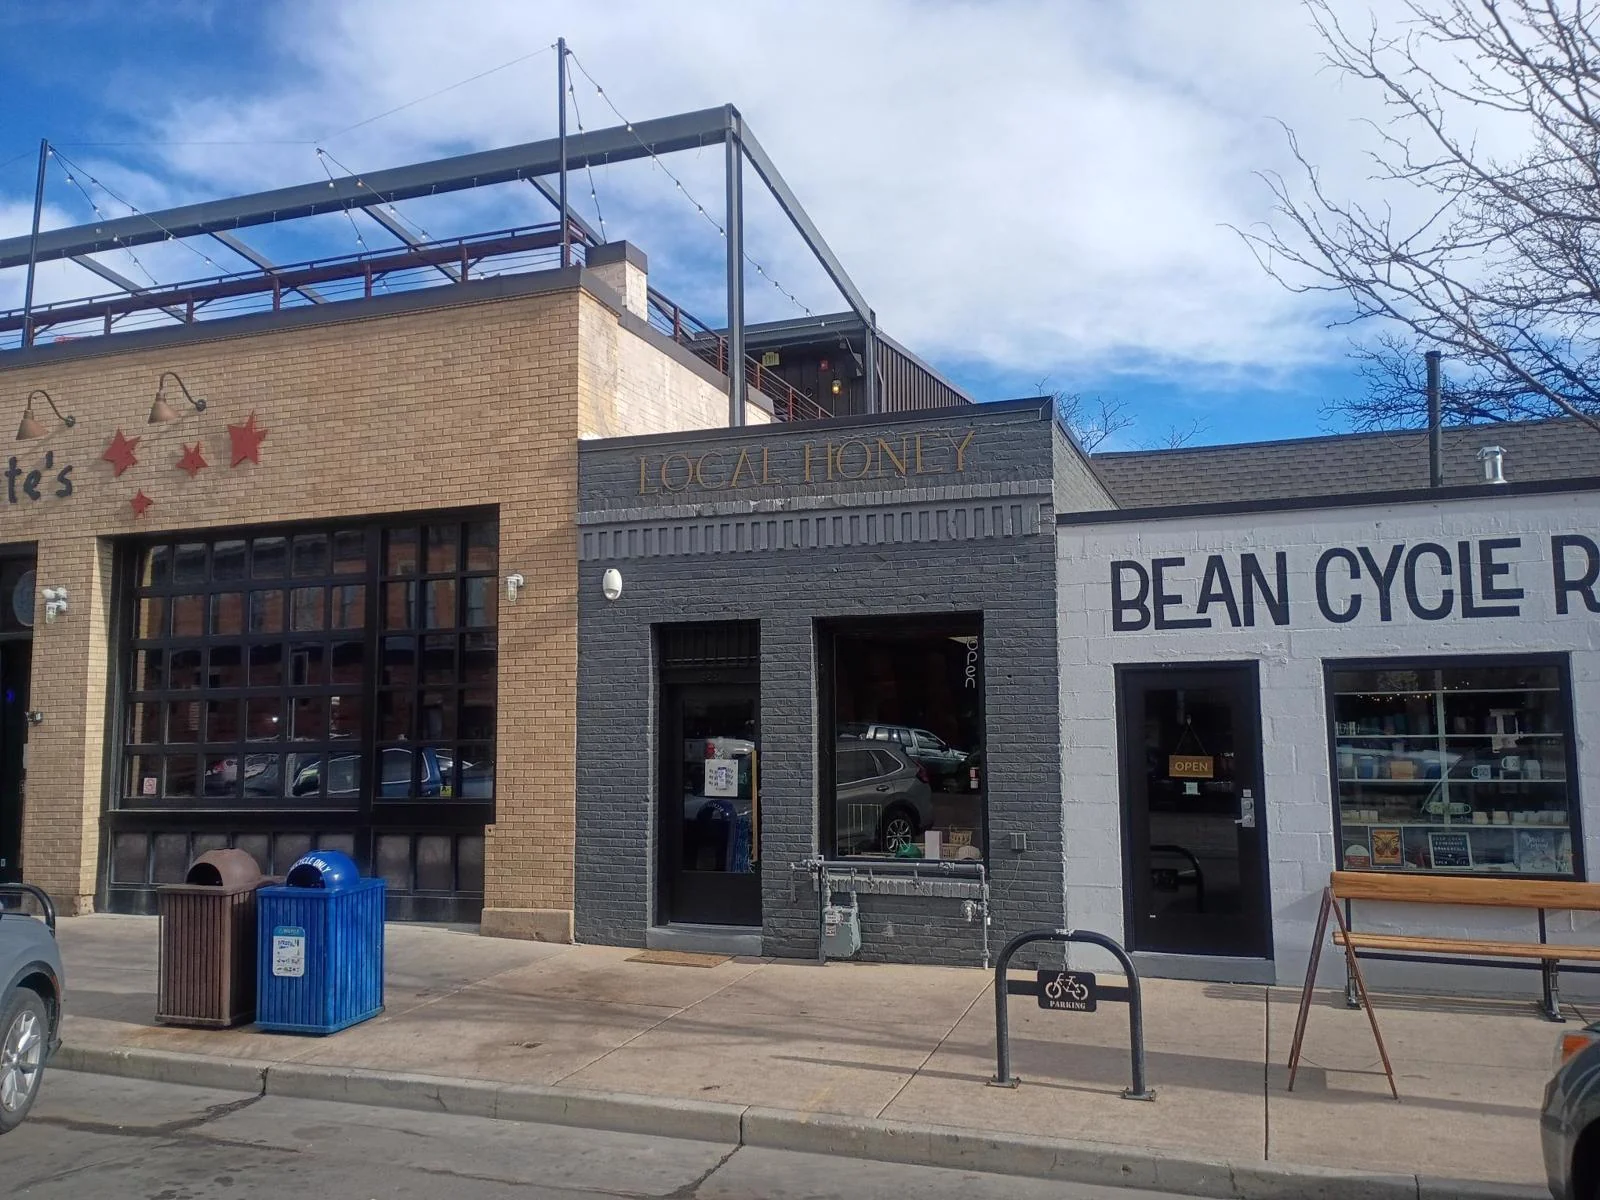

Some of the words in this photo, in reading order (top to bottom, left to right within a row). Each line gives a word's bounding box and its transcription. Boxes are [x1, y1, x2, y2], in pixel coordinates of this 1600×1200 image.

[639, 446, 782, 495] LOCAL
[803, 430, 976, 483] HONEY
[1109, 551, 1291, 631] BEAN
[1315, 537, 1525, 623] CYCLE
[1174, 761, 1208, 772] OPEN
[288, 856, 316, 871] CYCLE
[312, 858, 333, 873] ONLY
[1049, 1000, 1086, 1009] PARKING
